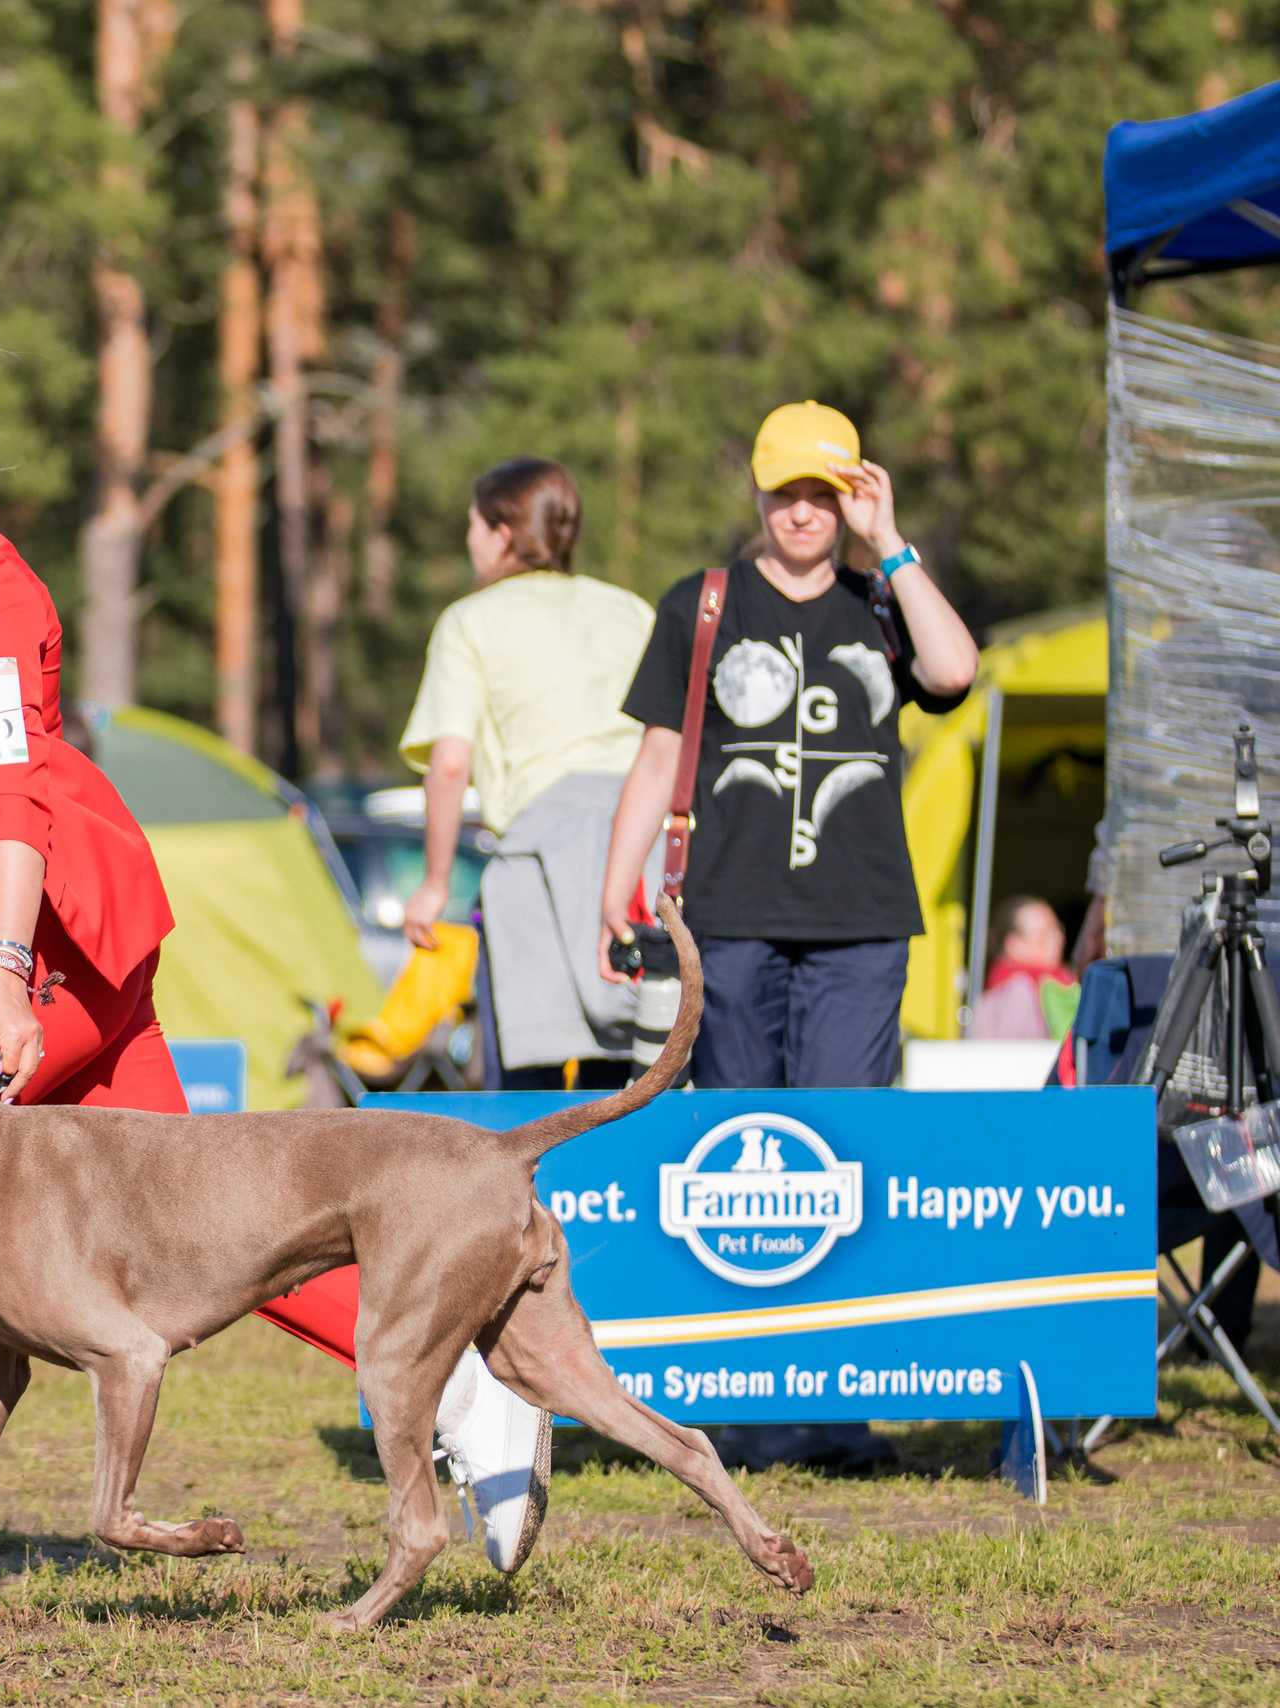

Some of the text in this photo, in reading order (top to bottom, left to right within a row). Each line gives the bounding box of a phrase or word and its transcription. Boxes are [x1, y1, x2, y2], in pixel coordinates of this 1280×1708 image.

[551, 1181, 637, 1224] pet.
[682, 1180, 840, 1218] Farmina
[888, 1176, 1125, 1229] Happy you.
[718, 1233, 805, 1255] Pet Foods
[664, 1366, 774, 1405] System
[785, 1365, 828, 1396] for
[837, 1362, 1003, 1397] Carnivores
